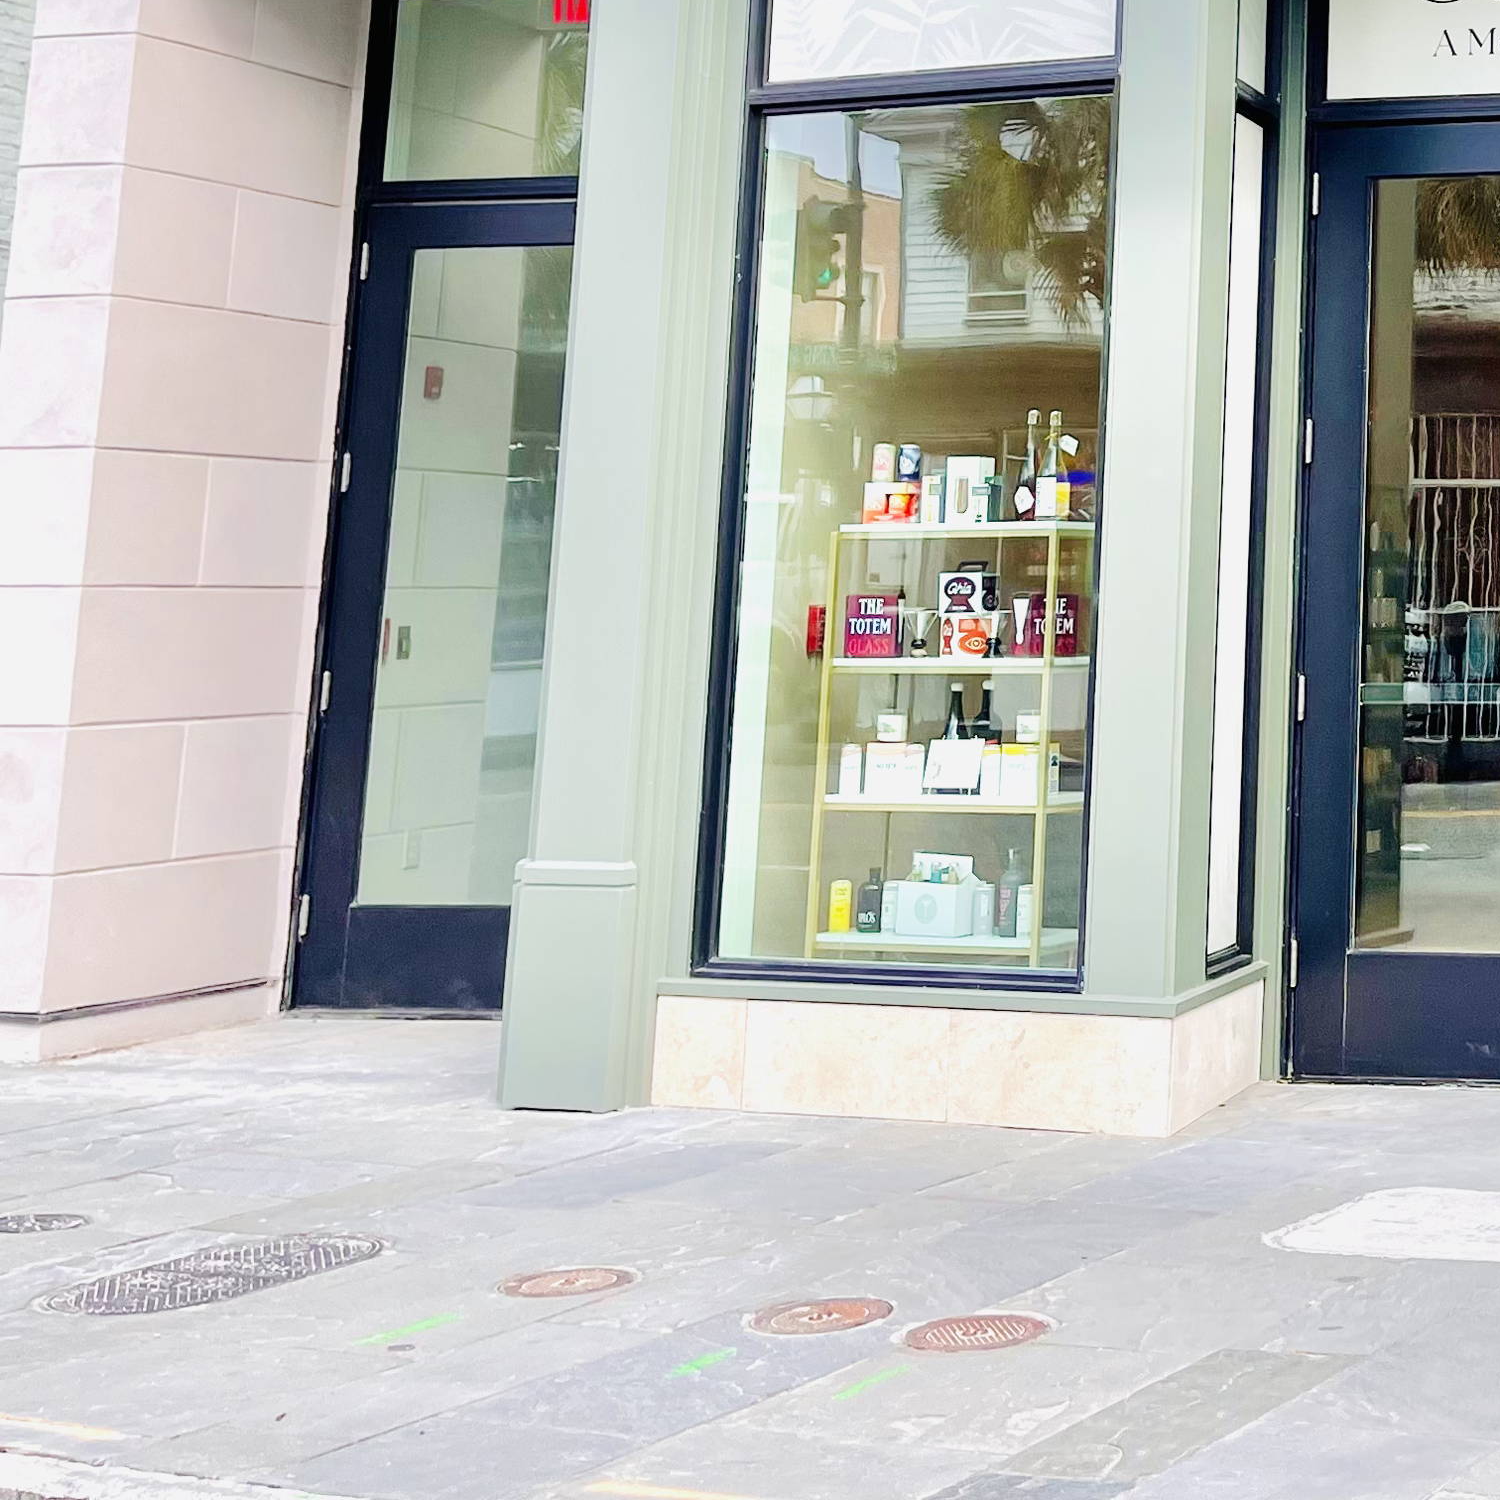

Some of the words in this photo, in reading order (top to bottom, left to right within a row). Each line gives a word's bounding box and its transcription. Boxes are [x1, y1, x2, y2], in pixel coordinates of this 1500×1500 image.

[1432, 29, 1458, 57] A
[858, 598, 885, 615] THE
[848, 618, 892, 635] TOTEM
[1033, 617, 1075, 635] TEM
[849, 638, 889, 655] GLASS
